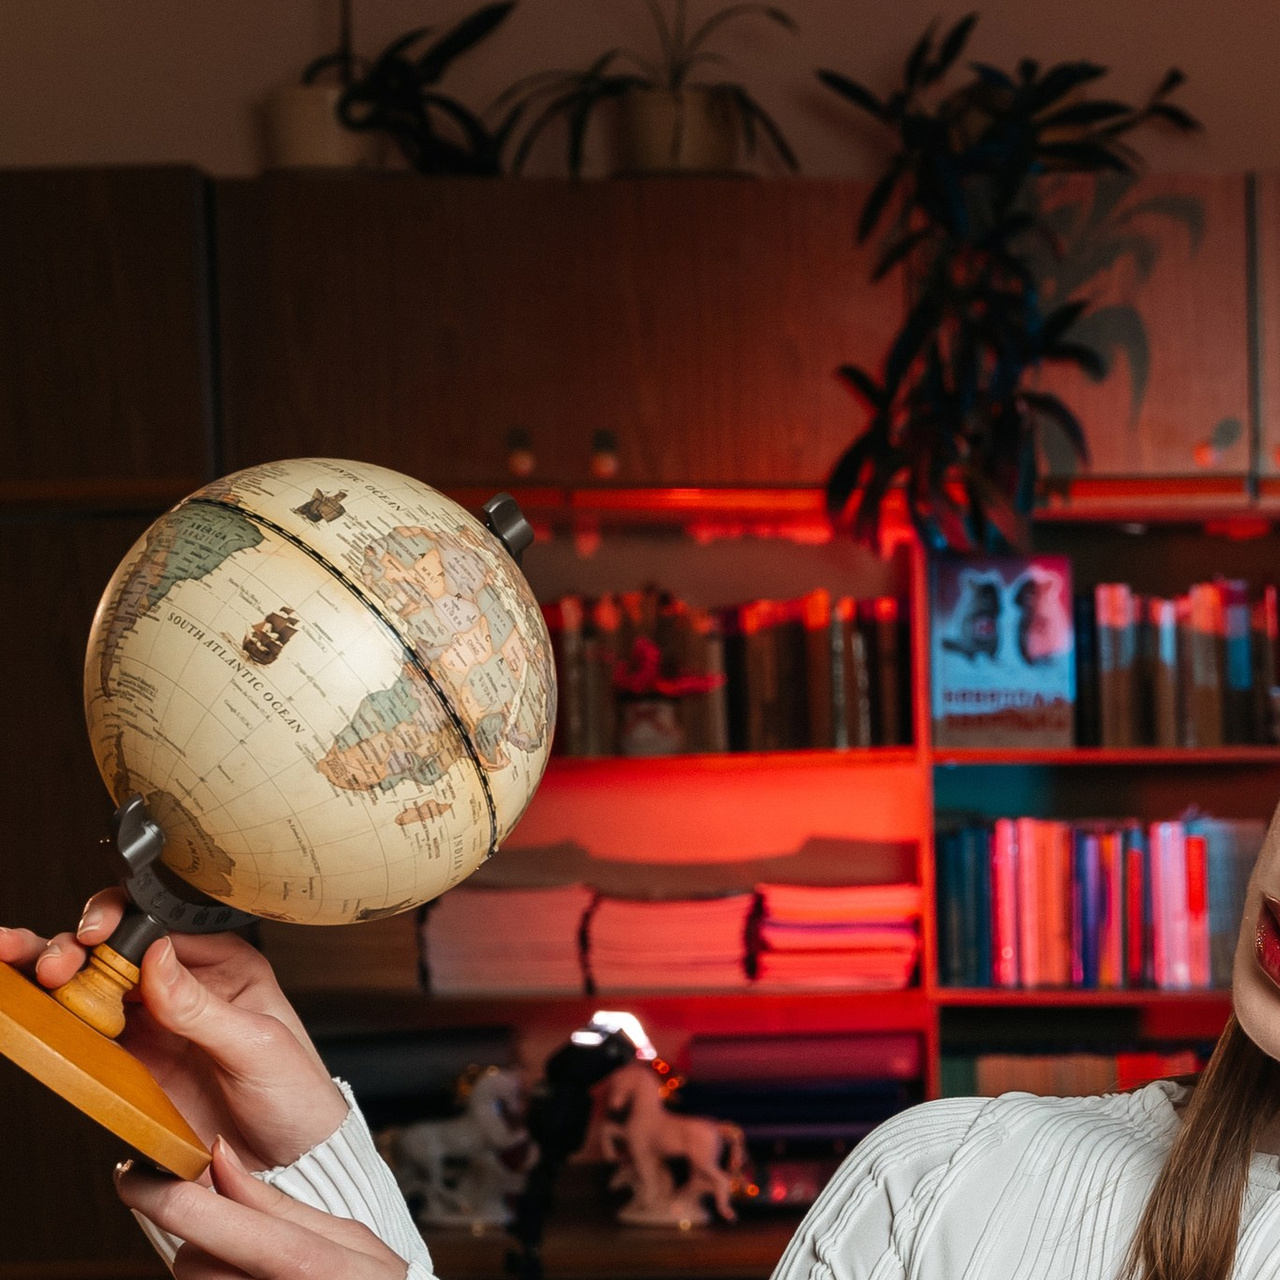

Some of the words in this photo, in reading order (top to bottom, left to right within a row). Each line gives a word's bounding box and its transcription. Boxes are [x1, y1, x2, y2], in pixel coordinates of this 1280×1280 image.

[365, 484, 409, 512] OCEAN
[421, 566, 440, 585] MALI
[442, 601, 463, 627] NIGER
[167, 611, 206, 641] SOUTH
[203, 639, 265, 692] ATLANTIC
[263, 692, 306, 735] OCEAN
[453, 833, 464, 870] INDIAN
